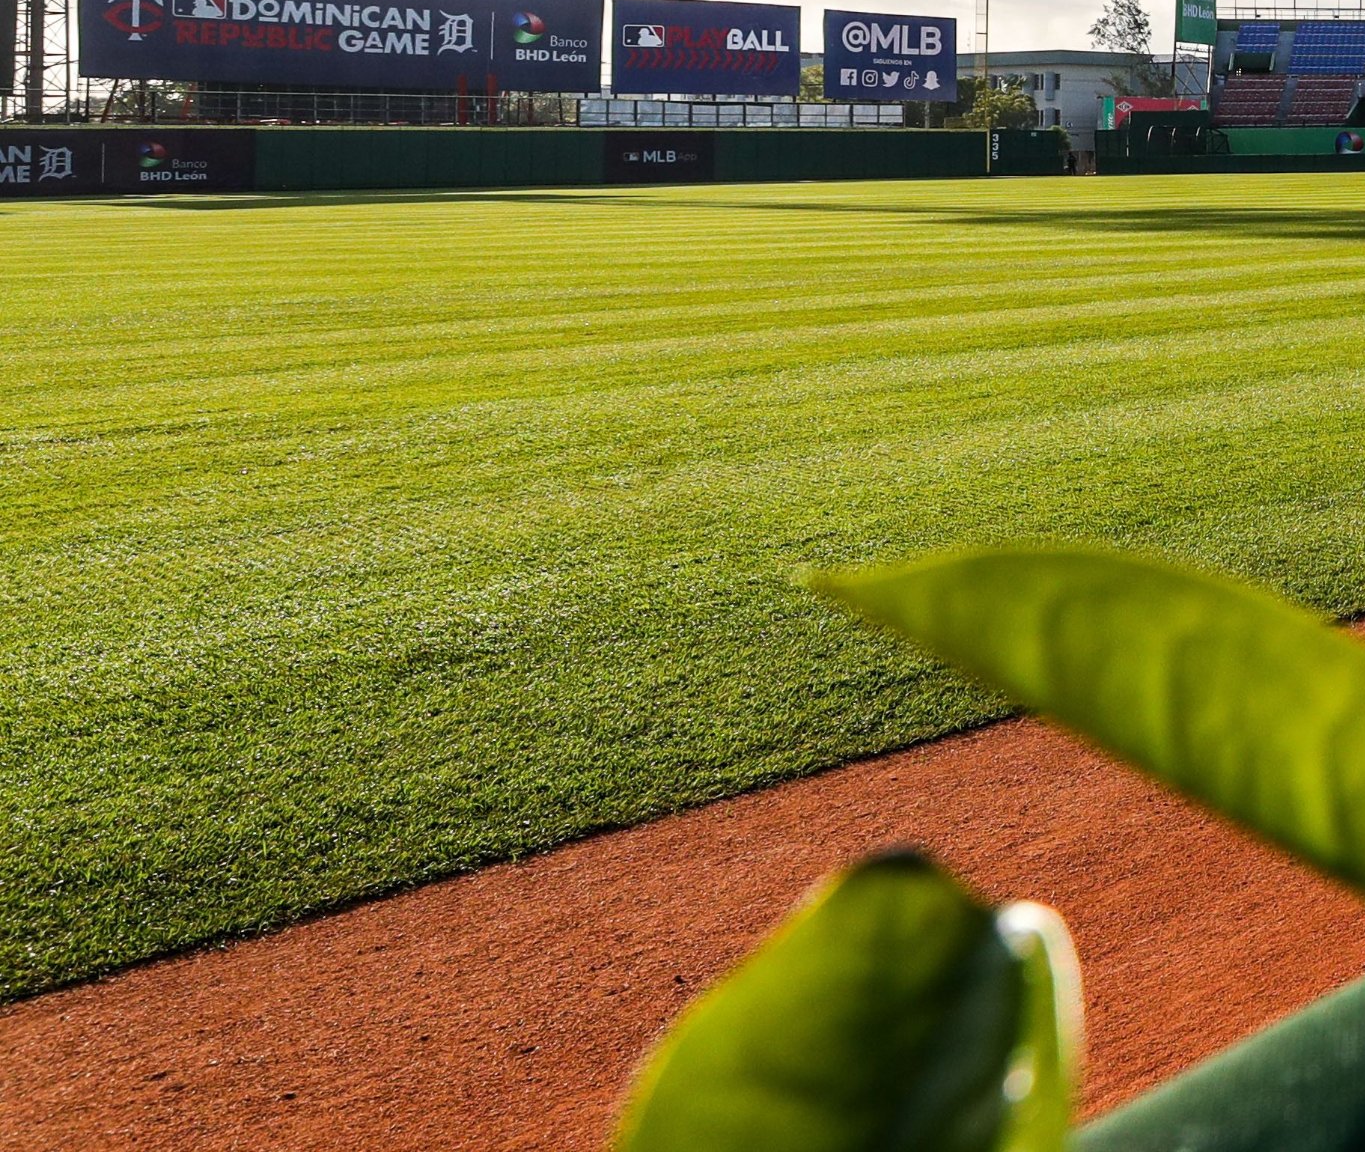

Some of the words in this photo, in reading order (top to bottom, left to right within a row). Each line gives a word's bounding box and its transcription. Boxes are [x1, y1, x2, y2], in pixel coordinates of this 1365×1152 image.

[1183, 3, 1198, 17] BHD
[338, 30, 429, 55] GAME
[550, 35, 587, 48] Banco
[842, 21, 942, 56] @MLB
[515, 49, 550, 61] BHD
[552, 49, 587, 63] León
[643, 150, 676, 163] MLB
[172, 159, 207, 169] Banco
[140, 171, 171, 181] BHD
[175, 169, 207, 181] León
